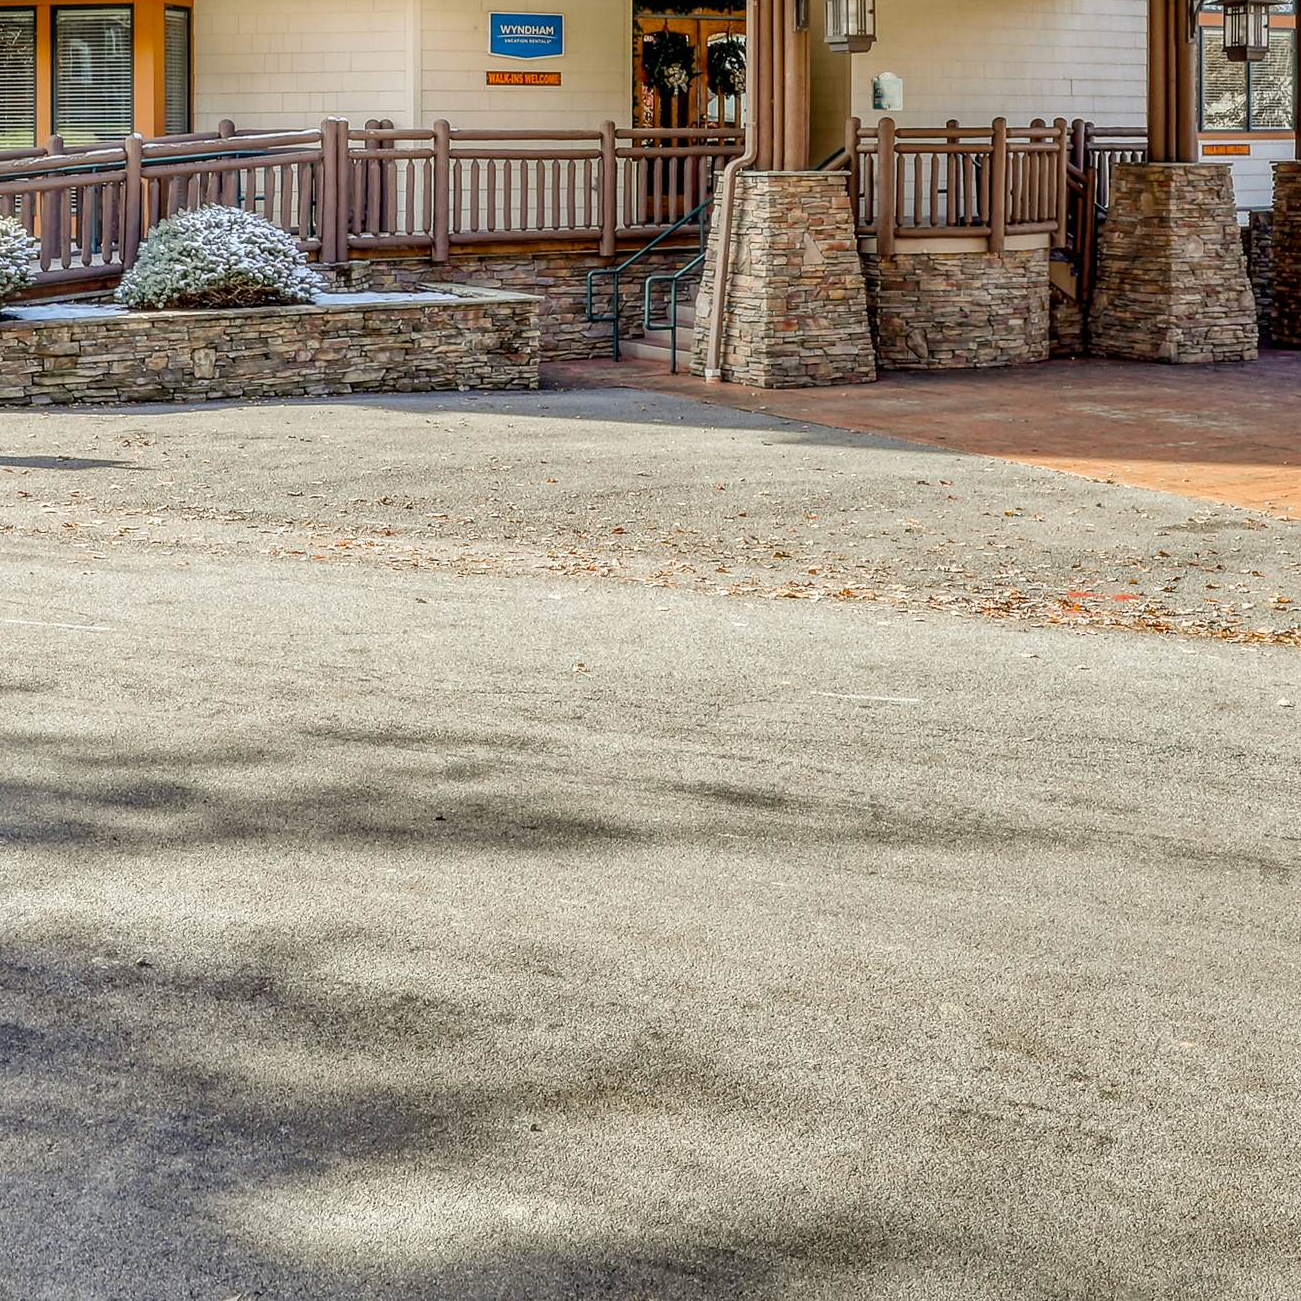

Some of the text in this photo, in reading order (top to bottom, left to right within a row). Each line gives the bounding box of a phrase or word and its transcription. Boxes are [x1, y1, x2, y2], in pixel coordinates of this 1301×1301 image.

[500, 25, 554, 35] WYNDHAM
[488, 73, 559, 84] WALK-INS WELCOME
